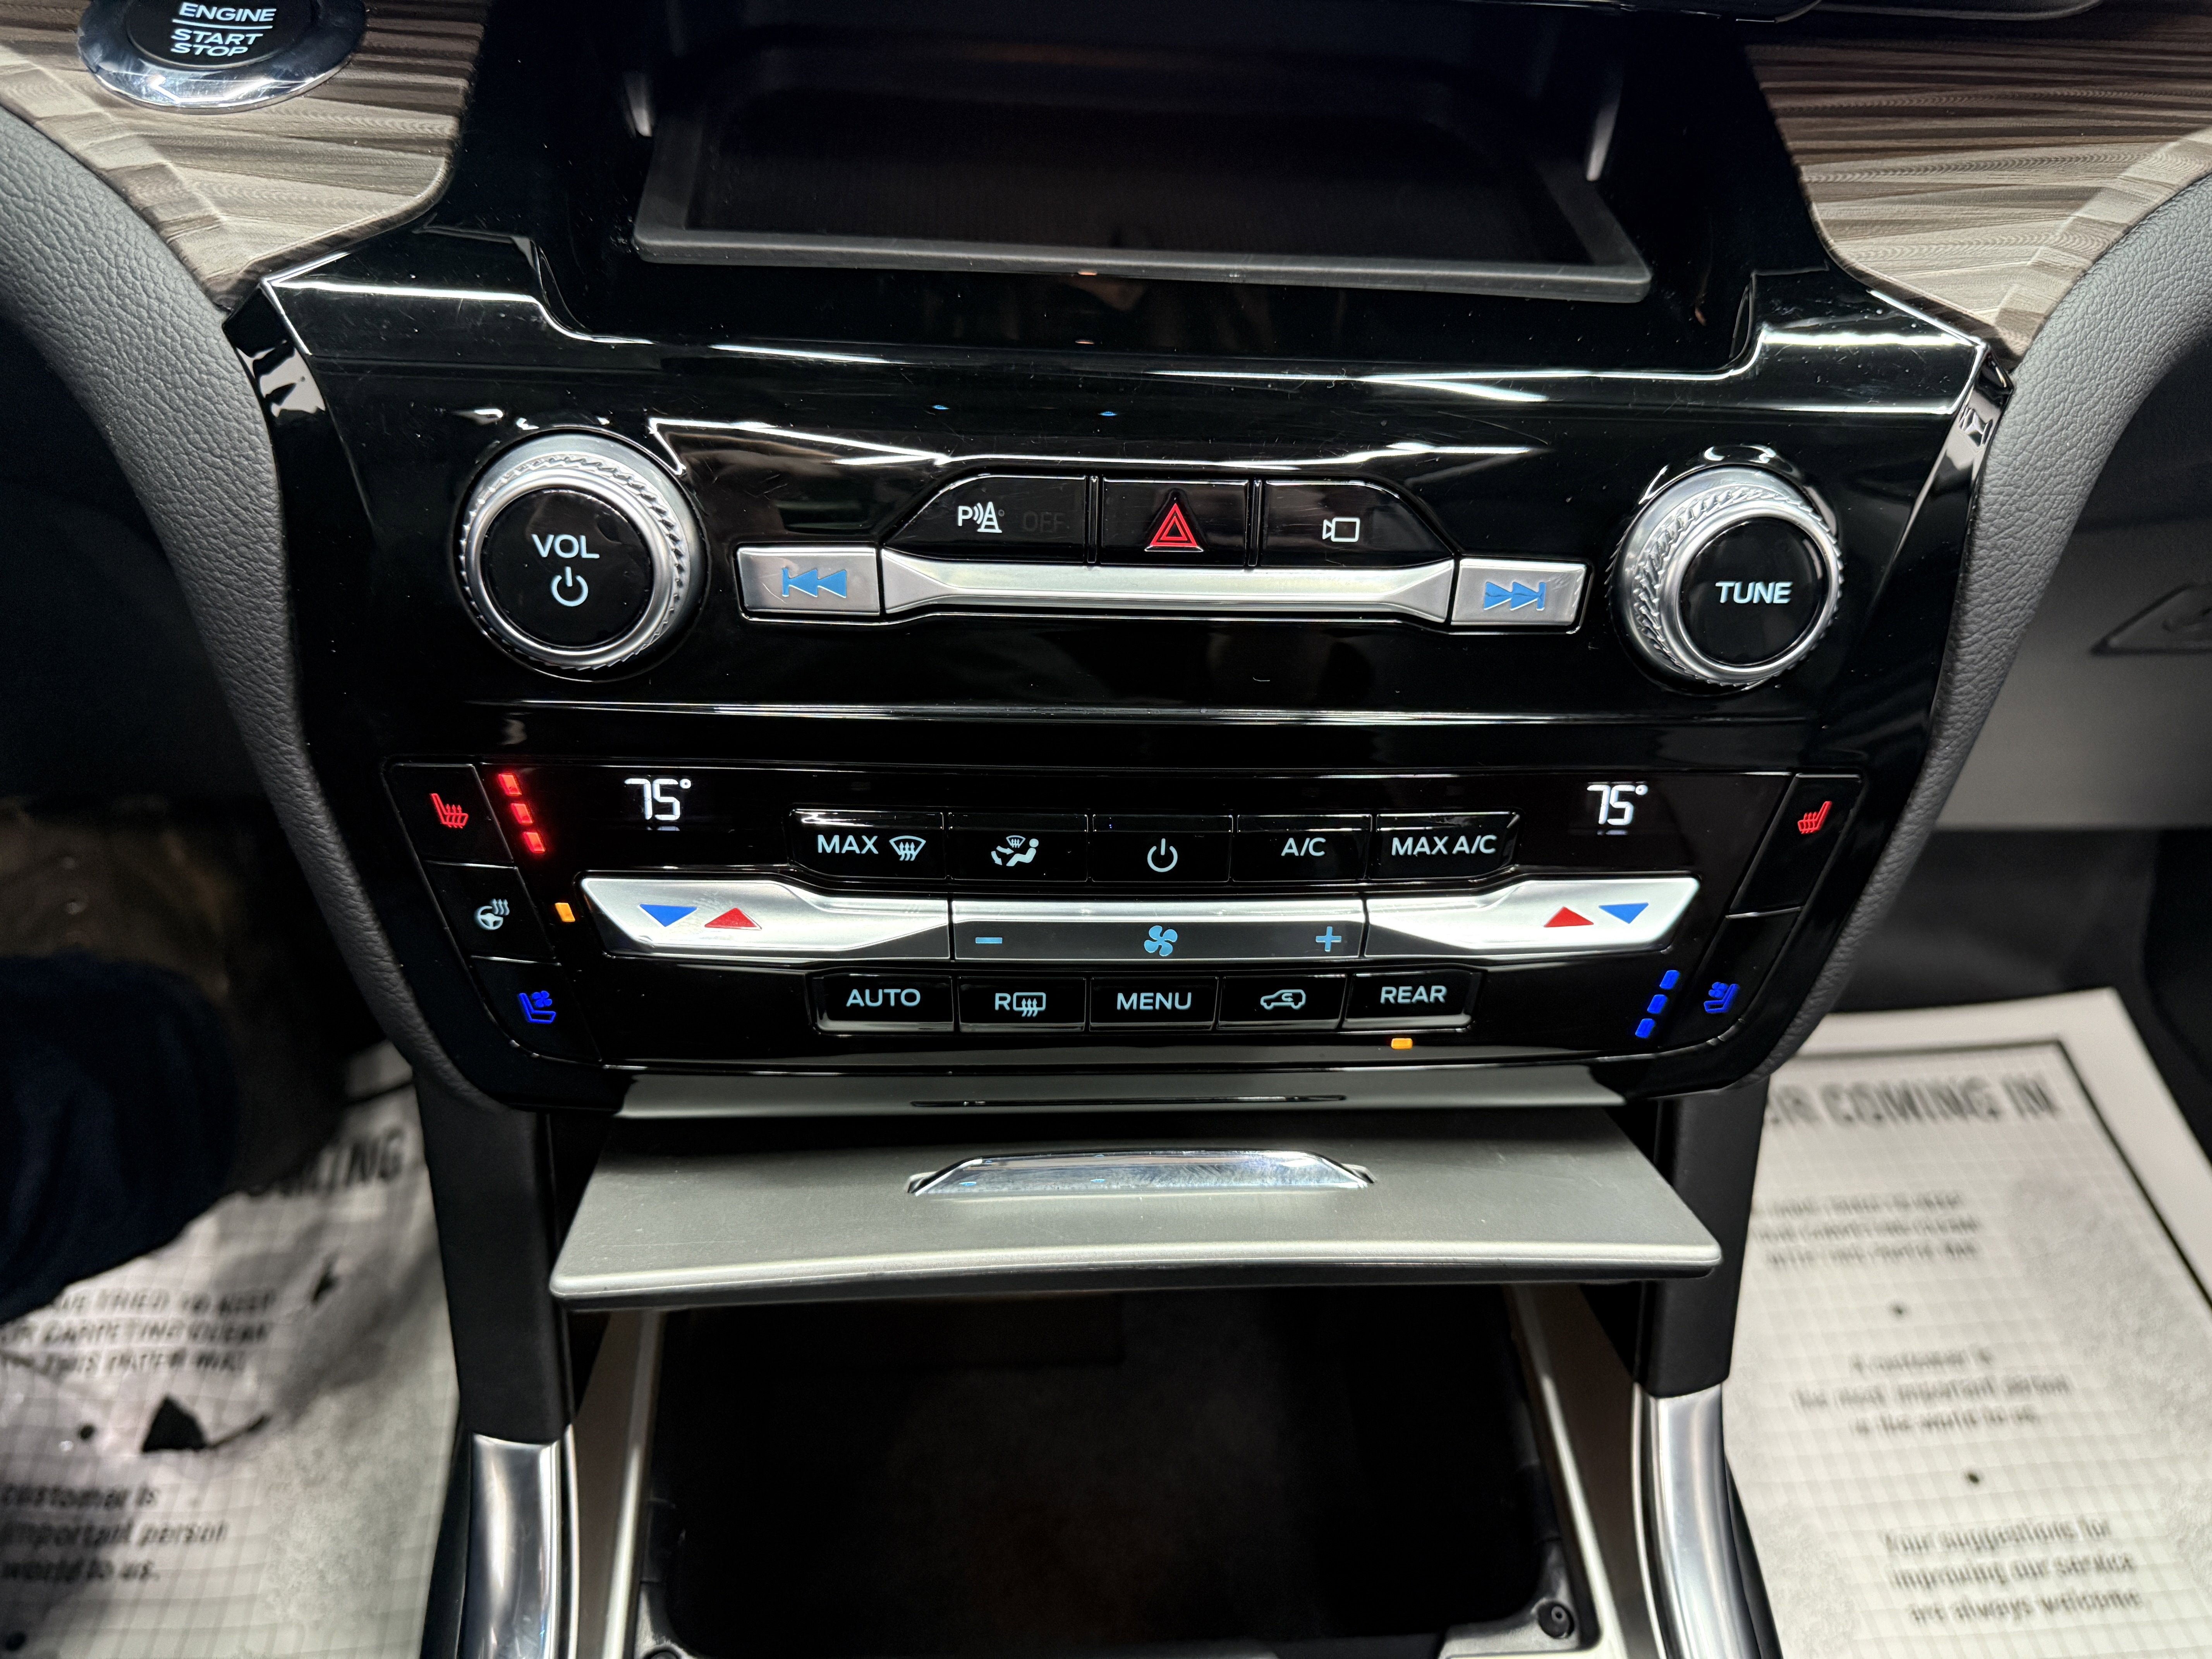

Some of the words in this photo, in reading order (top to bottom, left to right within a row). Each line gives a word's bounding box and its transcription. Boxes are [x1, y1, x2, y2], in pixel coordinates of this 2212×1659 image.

[179, 2, 277, 22] ENGINE
[171, 29, 263, 45] START
[170, 43, 248, 57] STOP
[531, 534, 600, 559] VOL
[1715, 581, 1792, 604] TUNE
[817, 835, 879, 854] MAX
[1281, 837, 1326, 856] A/C
[1391, 836, 1448, 857] MAX
[1452, 835, 1497, 854] A/C
[846, 988, 921, 1006] AUTO
[1117, 992, 1192, 1010] MENU
[1380, 985, 1446, 1003] REAR
[1820, 1075, 2004, 1125] COMING
